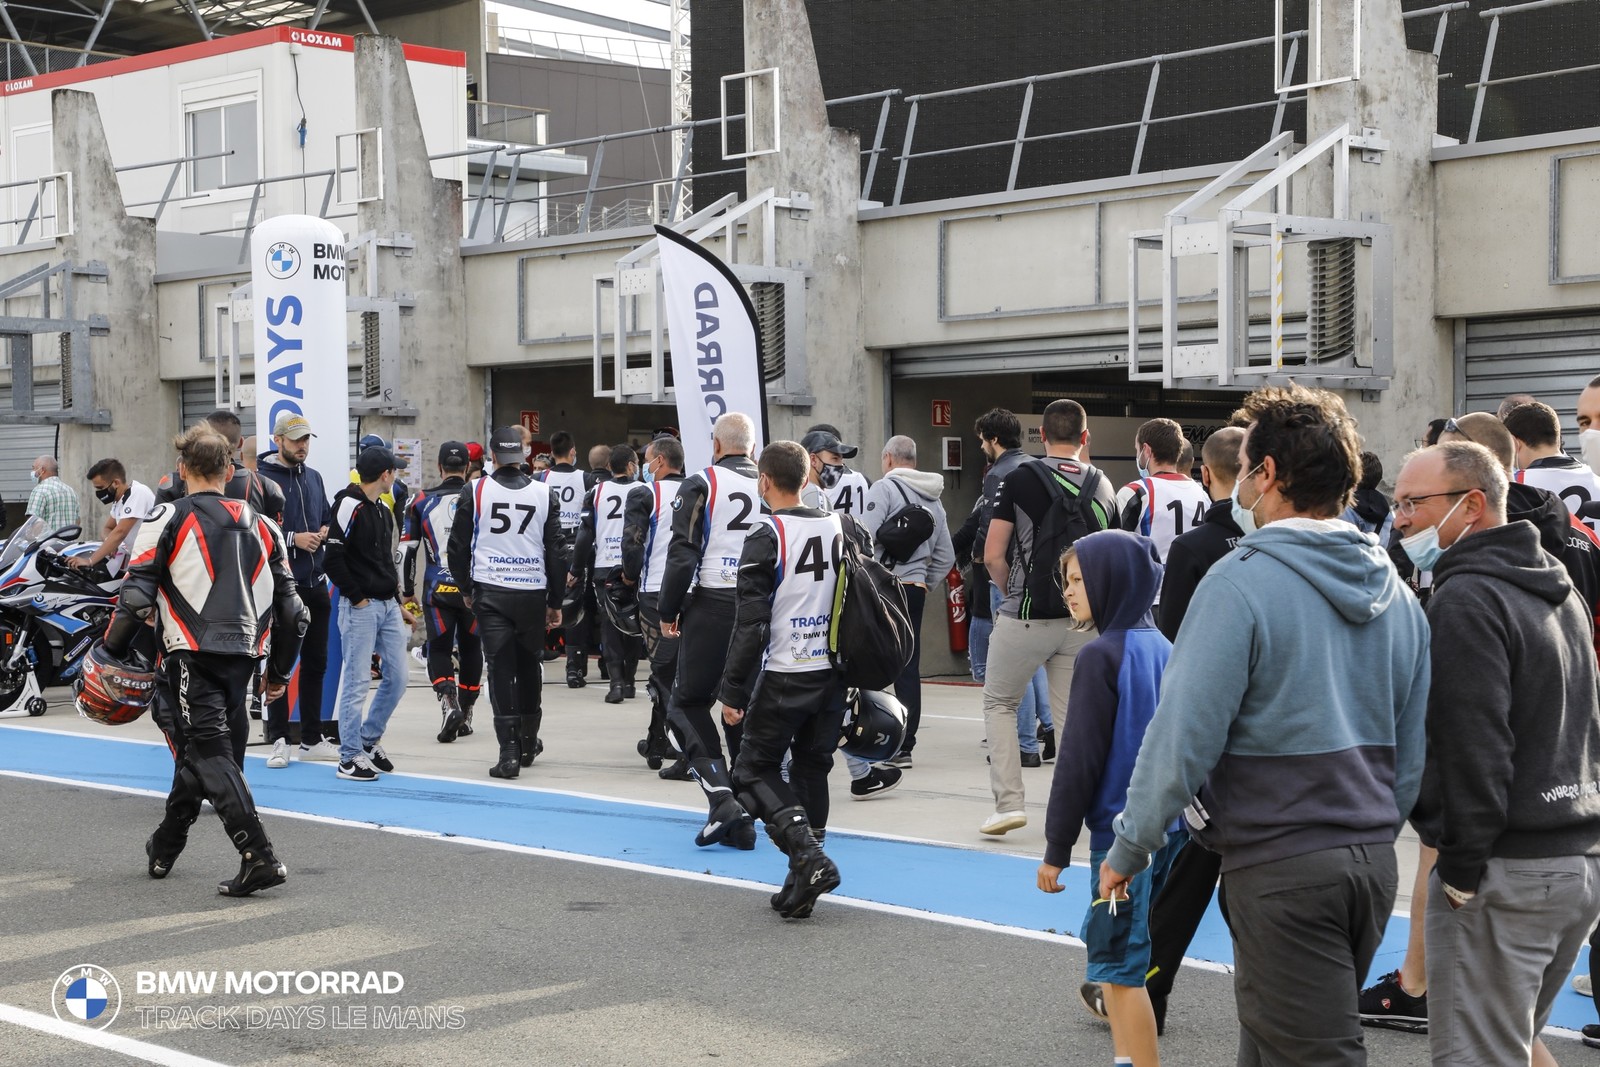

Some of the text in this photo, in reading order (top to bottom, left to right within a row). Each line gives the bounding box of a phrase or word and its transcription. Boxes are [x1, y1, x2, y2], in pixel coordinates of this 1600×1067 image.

[300, 32, 342, 48] LOXAM
[10, 79, 34, 91] LOXAM
[833, 485, 864, 515] 41
[490, 502, 537, 535] 57
[559, 511, 580, 519] DAYS
[1166, 500, 1206, 536] 14
[488, 556, 540, 564] TRACKDAYS
[721, 557, 740, 567] TR
[803, 631, 821, 640] BMW
[811, 649, 831, 657] MIC
[1540, 783, 1580, 803] WHERE
